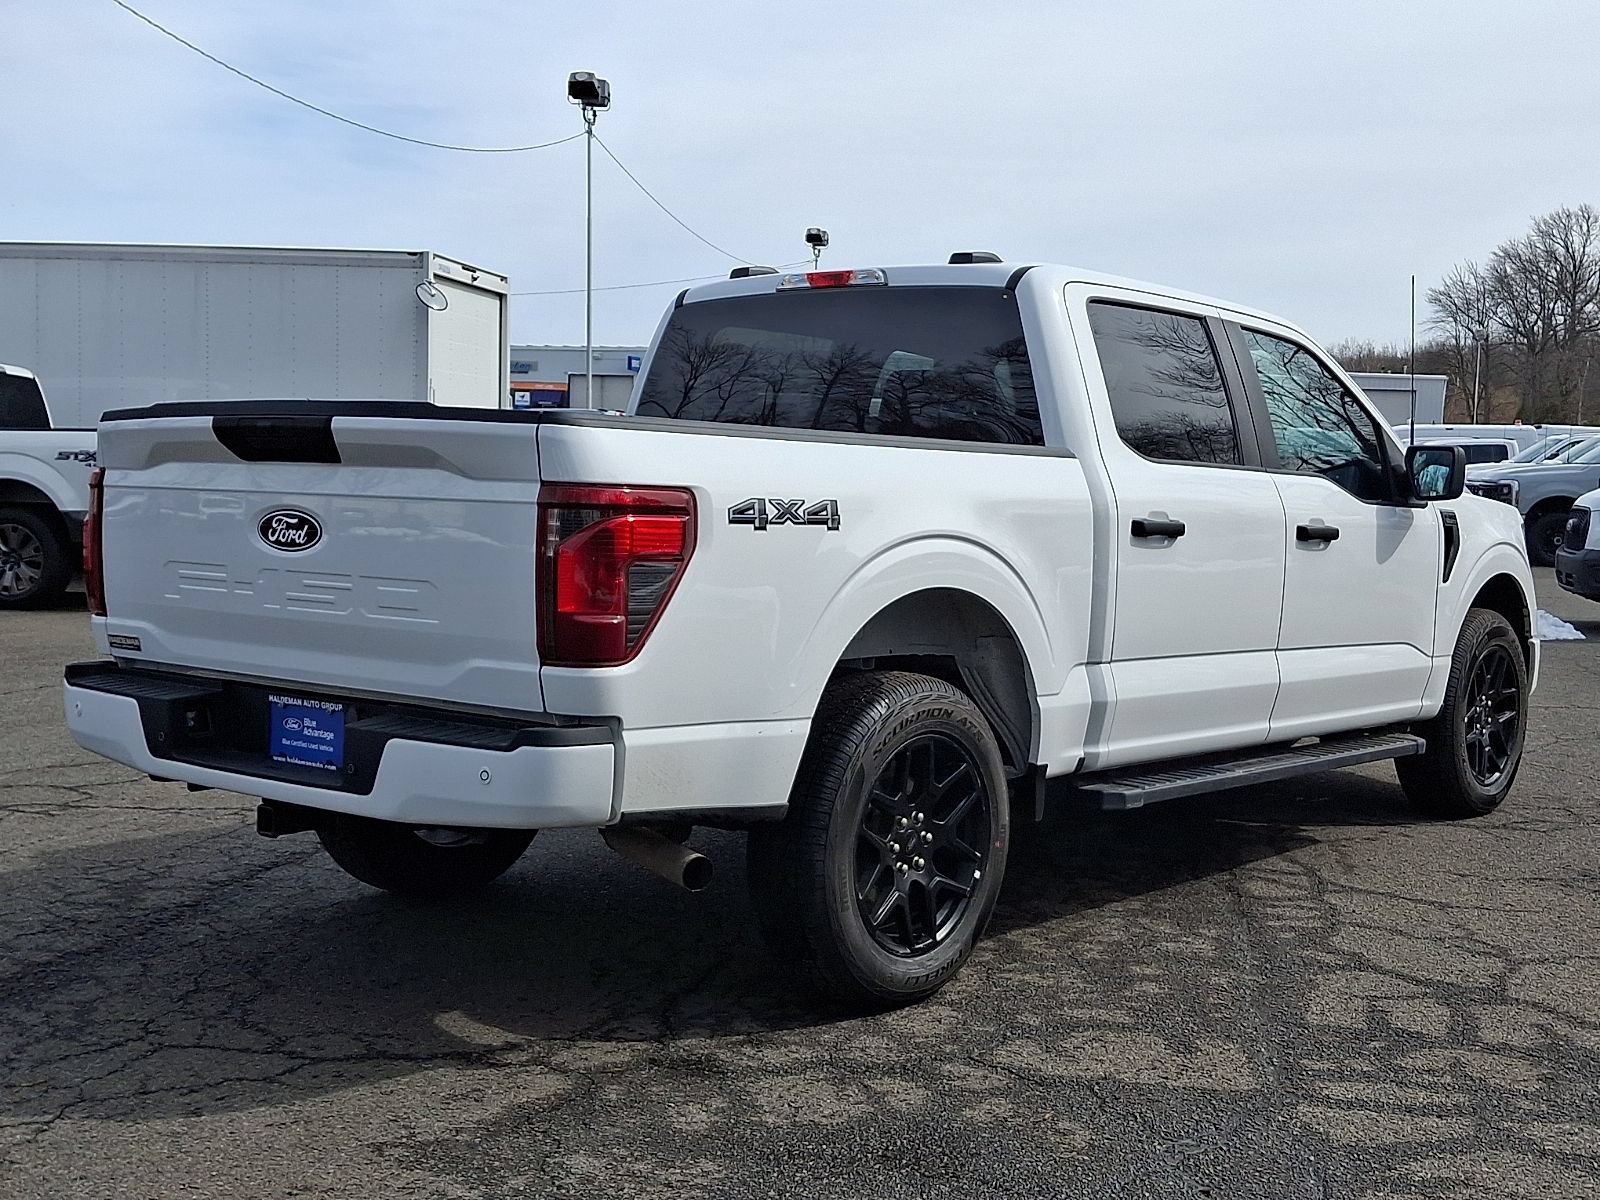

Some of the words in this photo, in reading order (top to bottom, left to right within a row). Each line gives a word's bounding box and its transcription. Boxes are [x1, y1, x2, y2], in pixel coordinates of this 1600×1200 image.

[268, 516, 309, 544] Ford
[164, 560, 440, 623] F-150
[269, 694, 302, 705] HALDEMAN
[303, 700, 320, 709] AUTO
[321, 702, 343, 711] GROUP
[303, 717, 317, 728] Blue
[303, 727, 335, 740] Advantage
